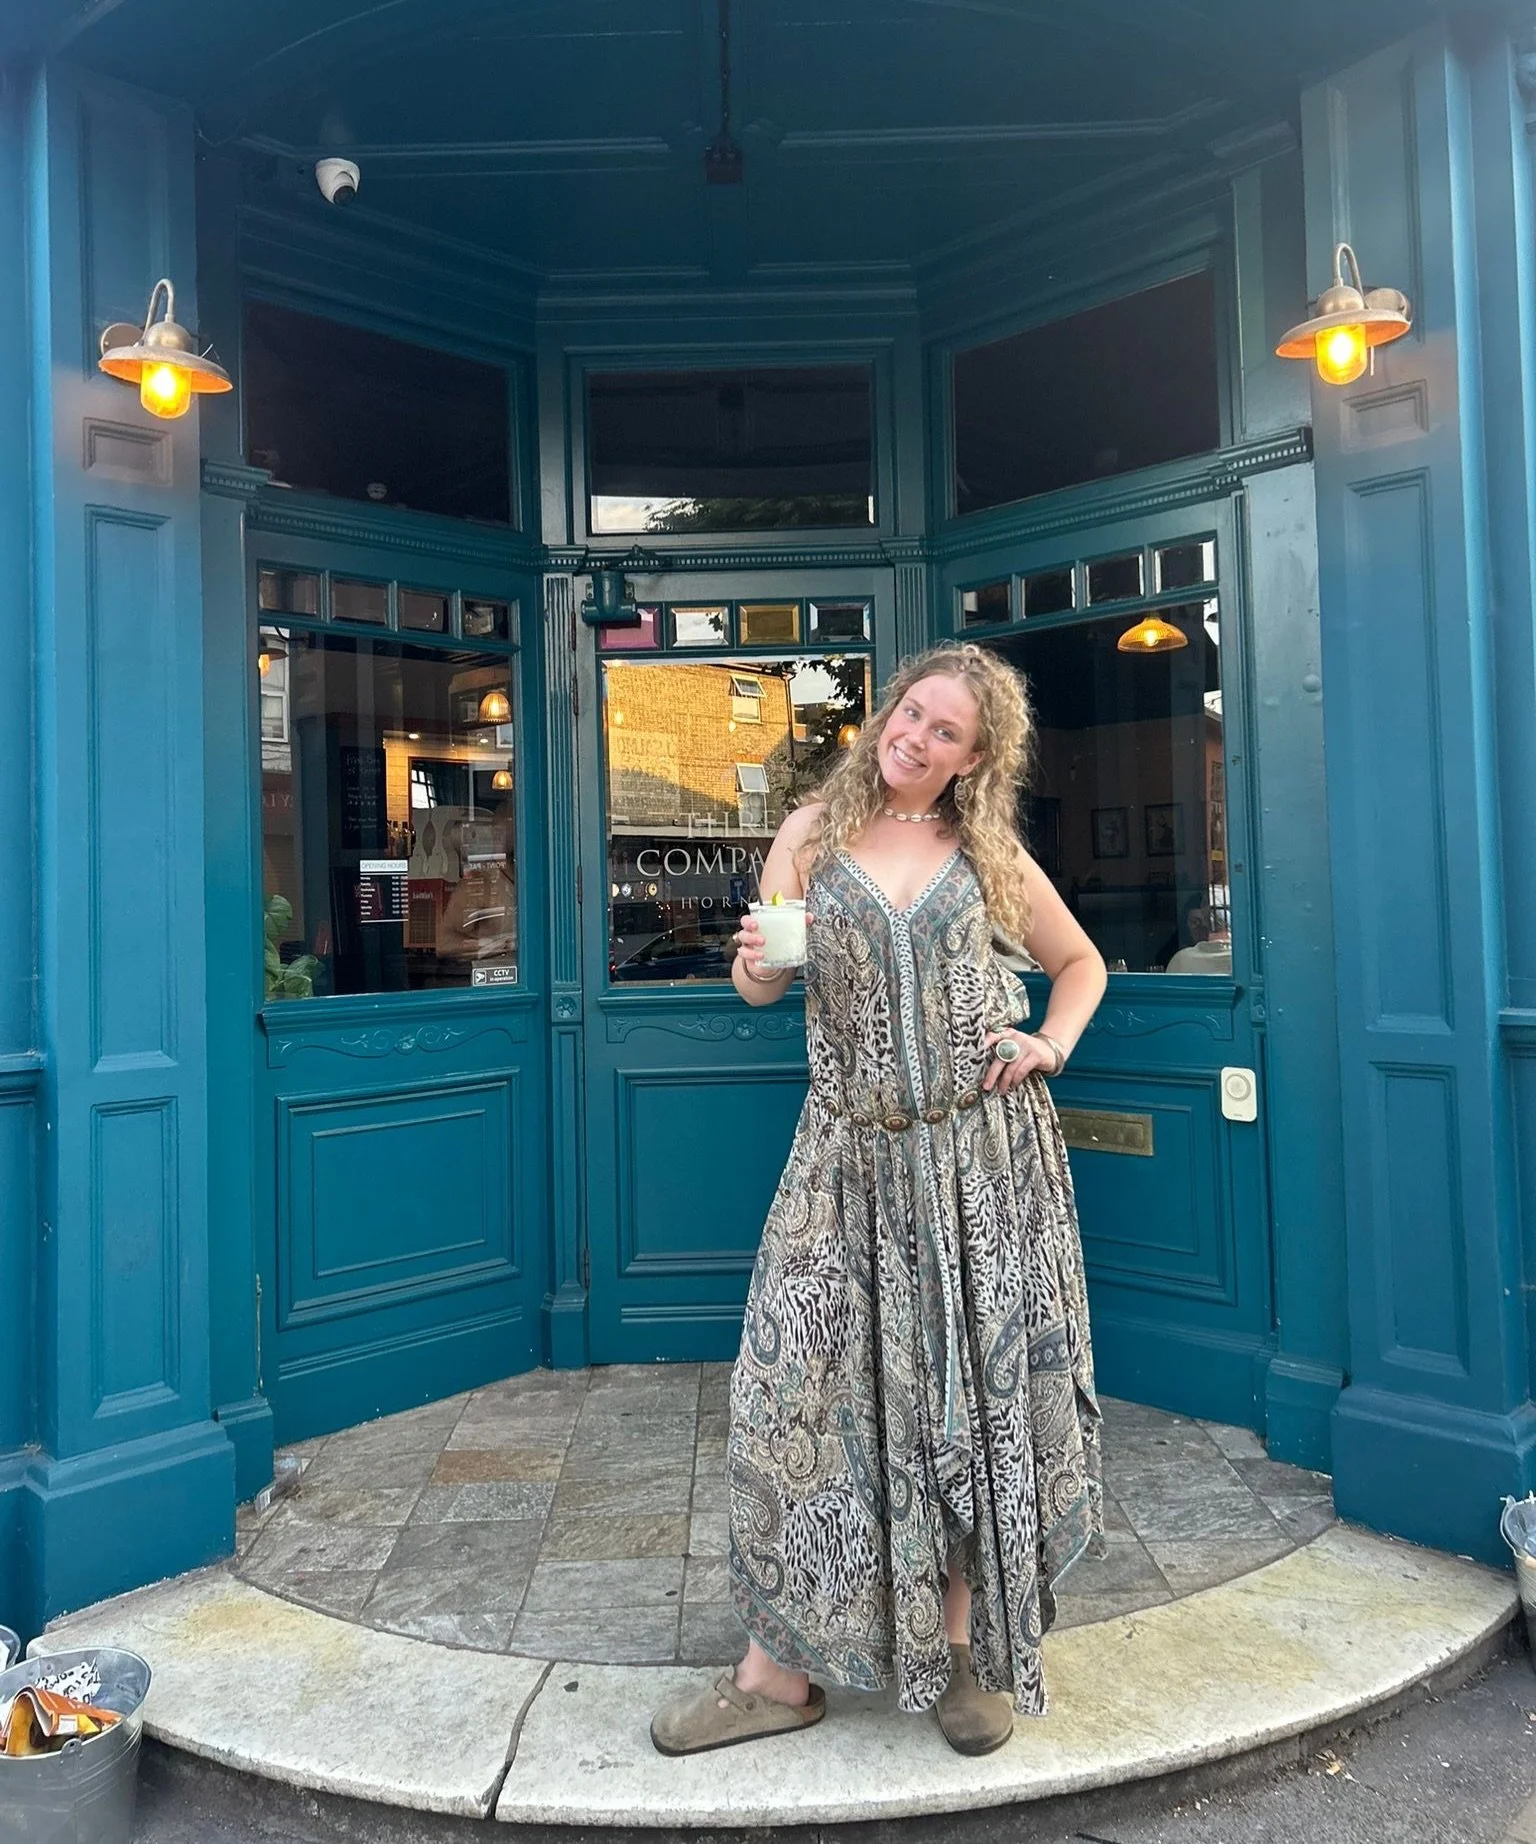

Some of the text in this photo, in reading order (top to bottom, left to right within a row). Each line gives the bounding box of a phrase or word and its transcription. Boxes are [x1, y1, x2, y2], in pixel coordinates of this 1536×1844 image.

[680, 811, 792, 838] THRE
[637, 847, 765, 876] COMPA
[682, 896, 754, 909] HORN
